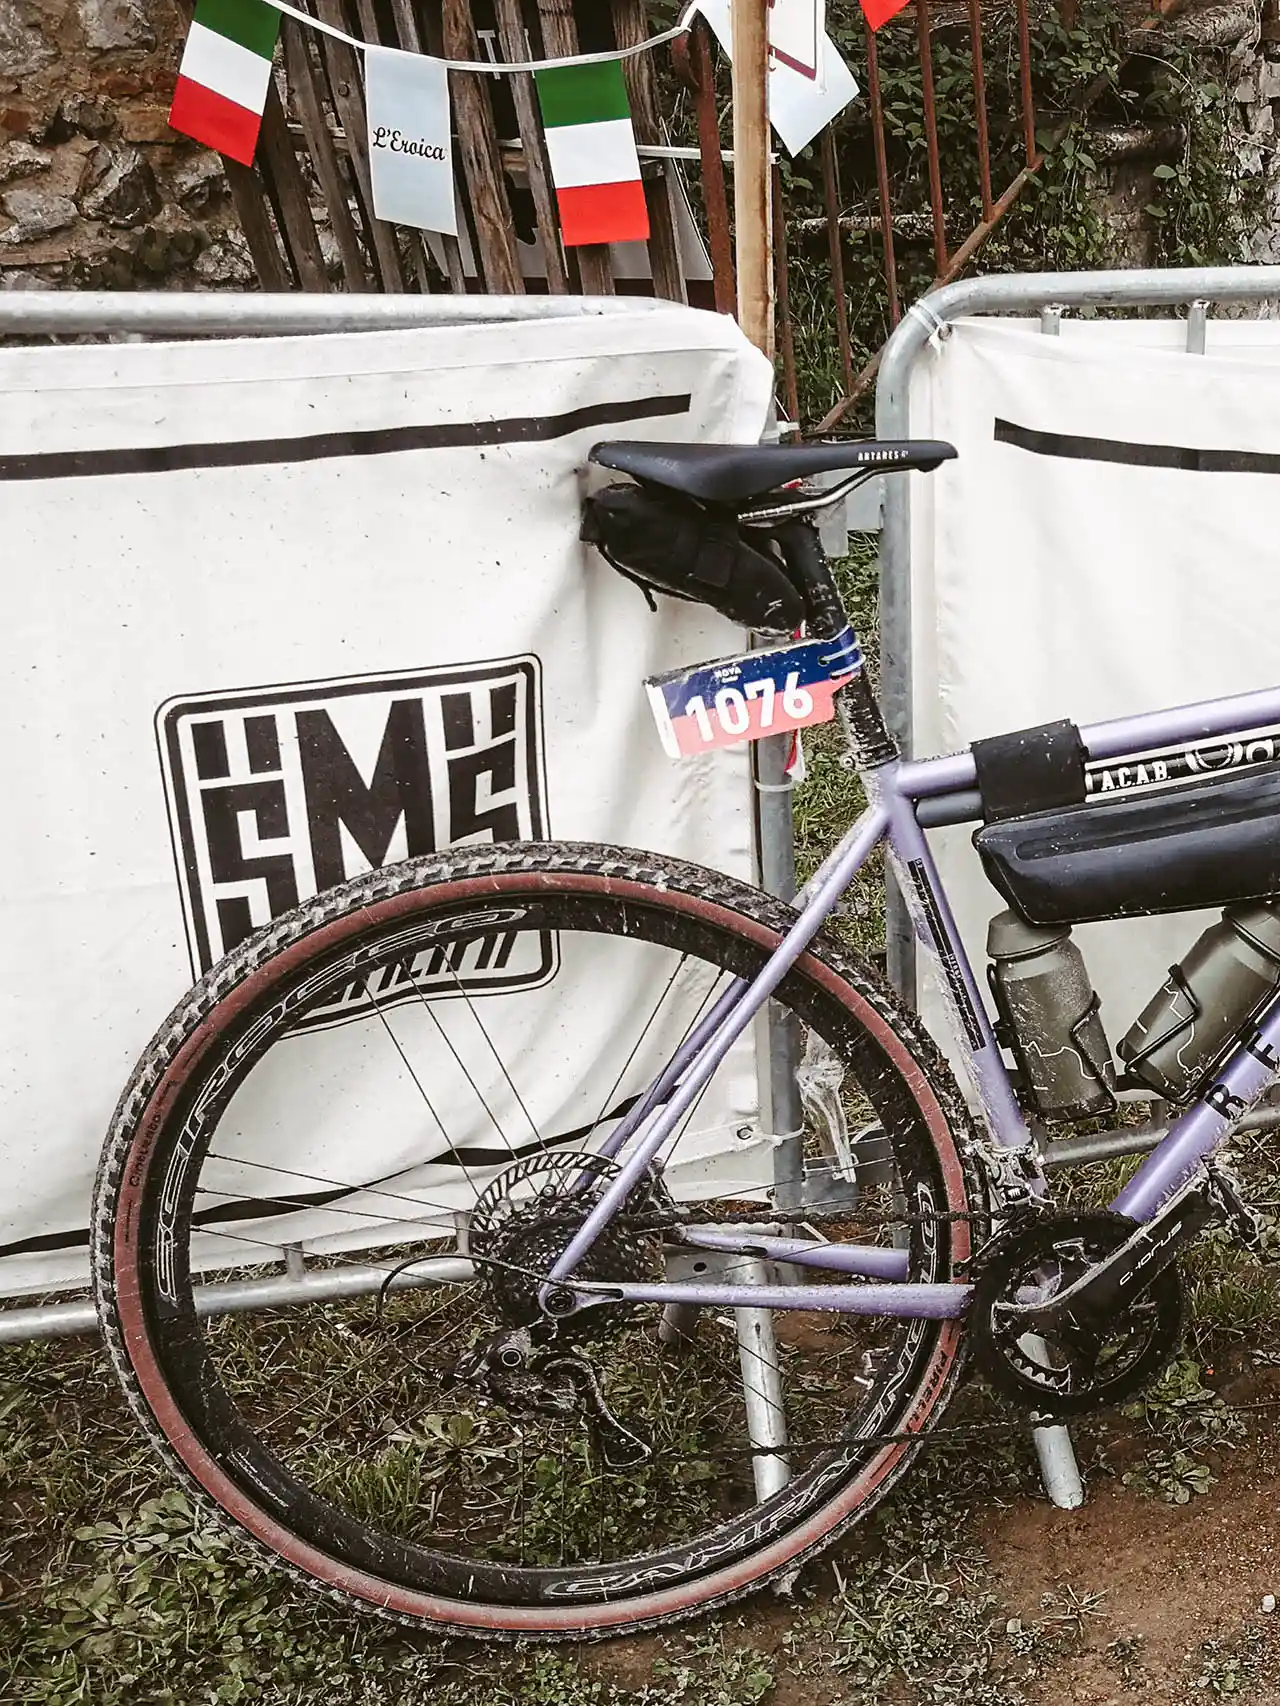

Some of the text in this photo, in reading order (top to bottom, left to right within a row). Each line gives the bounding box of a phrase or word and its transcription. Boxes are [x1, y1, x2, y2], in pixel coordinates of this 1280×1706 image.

[373, 127, 445, 160] L'Eroica
[858, 450, 899, 461] ANTARES
[684, 672, 814, 742] 1076
